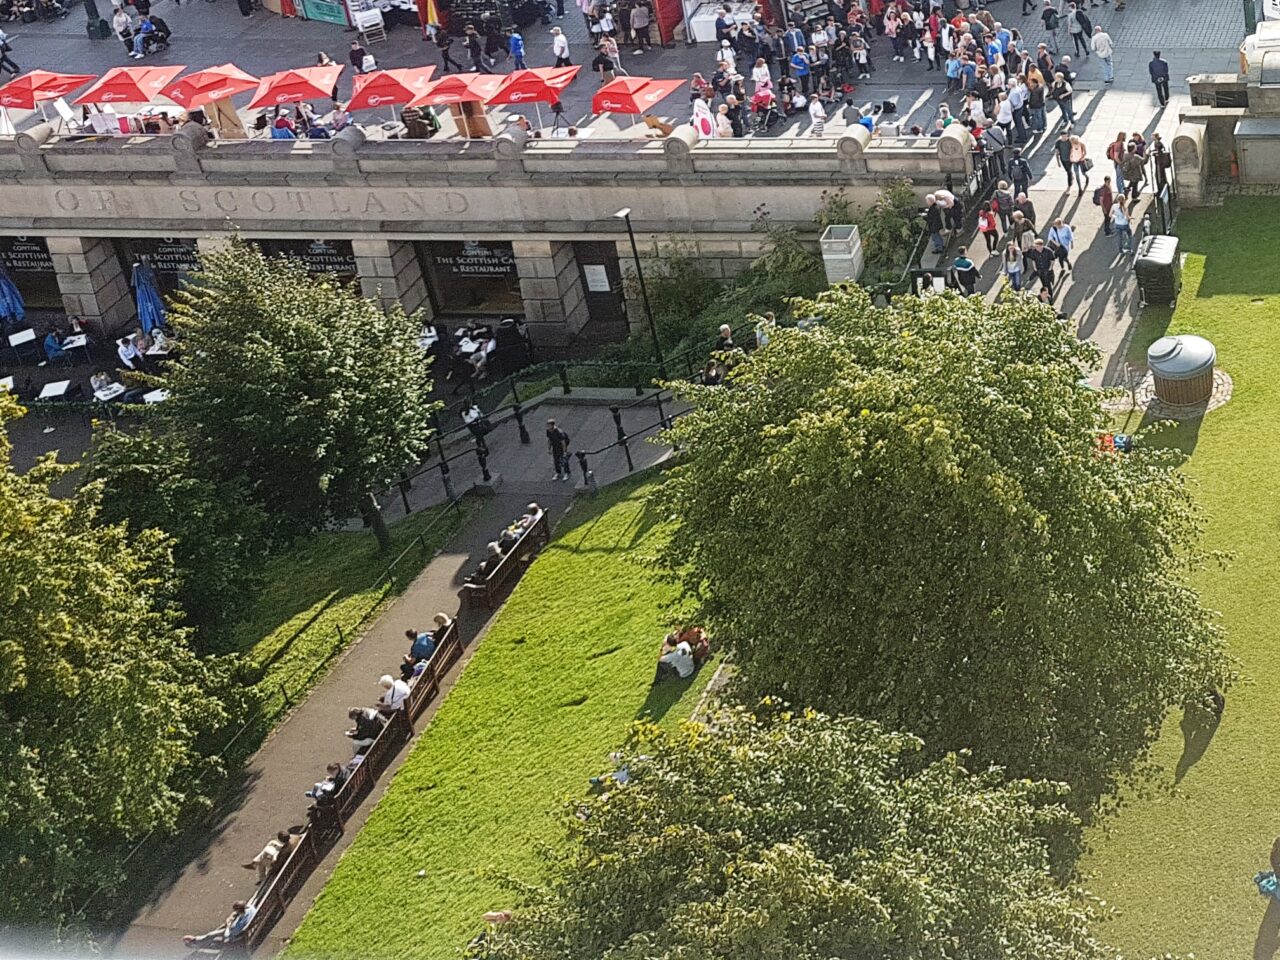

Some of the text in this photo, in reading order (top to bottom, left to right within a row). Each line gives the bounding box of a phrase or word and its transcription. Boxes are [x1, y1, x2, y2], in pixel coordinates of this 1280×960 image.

[55, 190, 470, 214] OF SCOTLAND
[436, 256, 453, 264] THE
[456, 256, 498, 264] SCOTTISH
[460, 265, 511, 273] RESTAURANT
